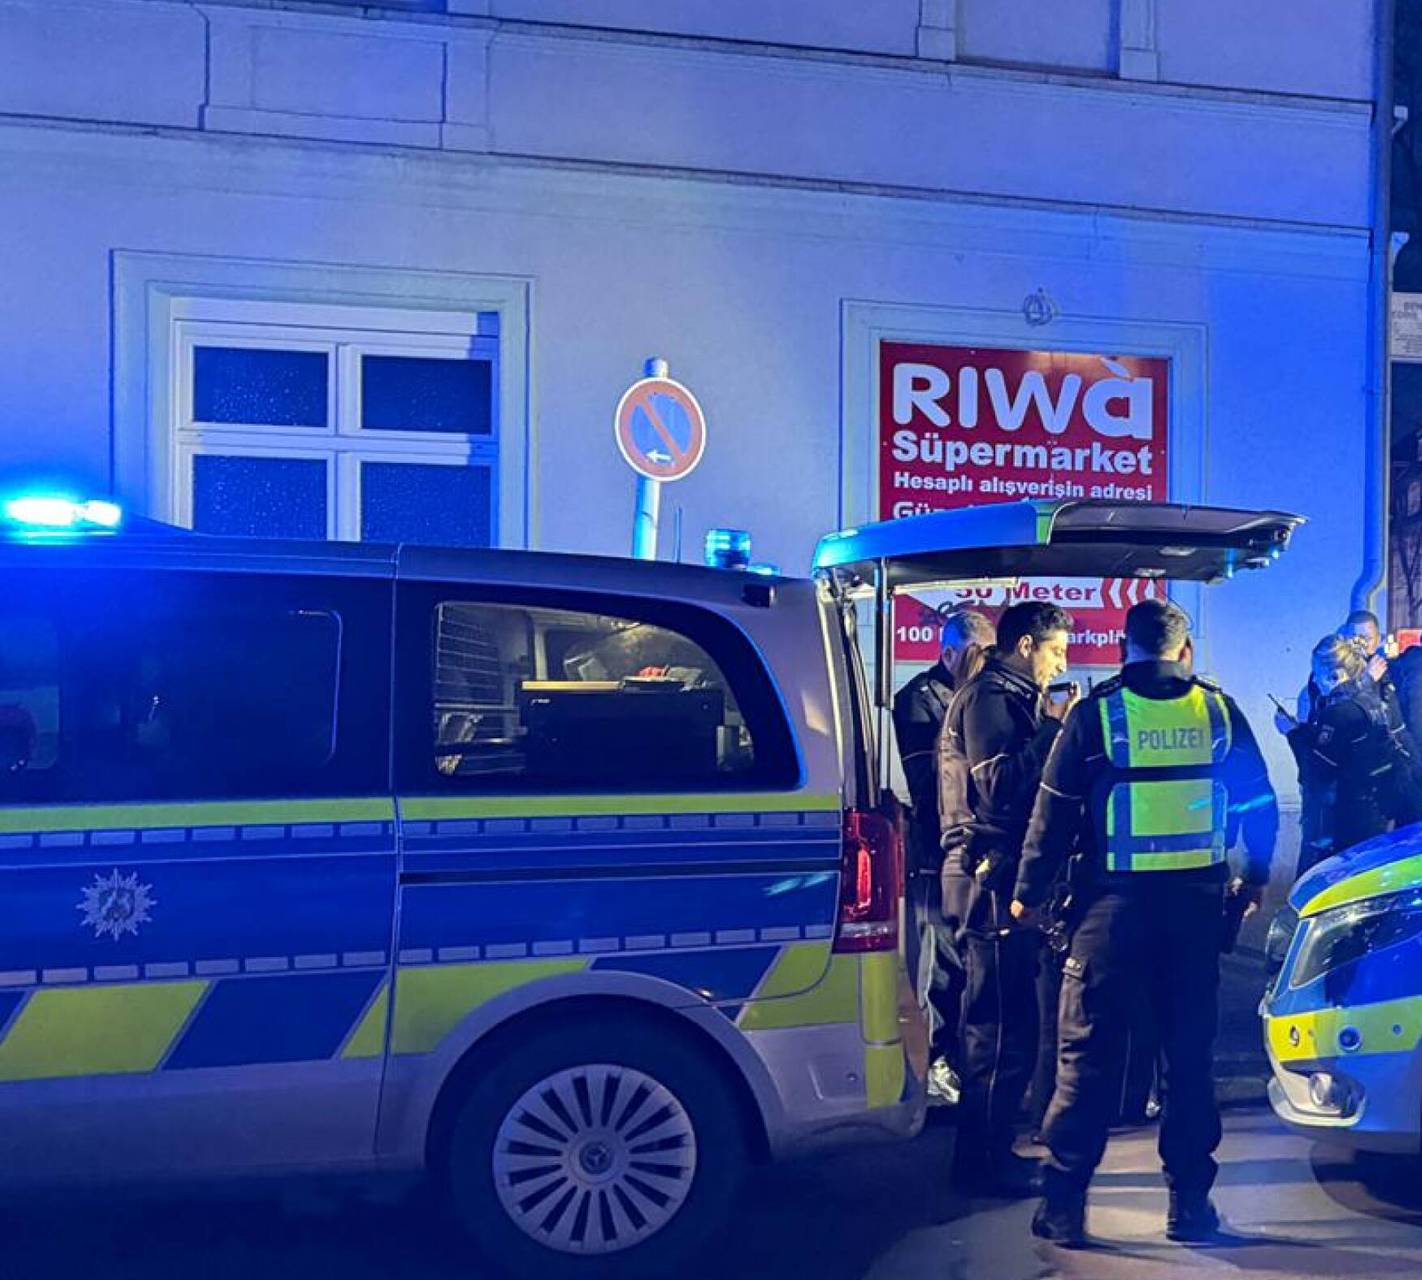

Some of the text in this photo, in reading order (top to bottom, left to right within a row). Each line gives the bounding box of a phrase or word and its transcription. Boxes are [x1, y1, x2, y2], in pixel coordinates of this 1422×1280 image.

[892, 430, 1153, 476] Süpermarket
[894, 471, 973, 494] Hesaplı
[1090, 482, 1153, 501] adresi
[1005, 581, 1097, 601] Meter
[896, 626, 933, 643] 100
[1137, 728, 1205, 750] POLIZEI
